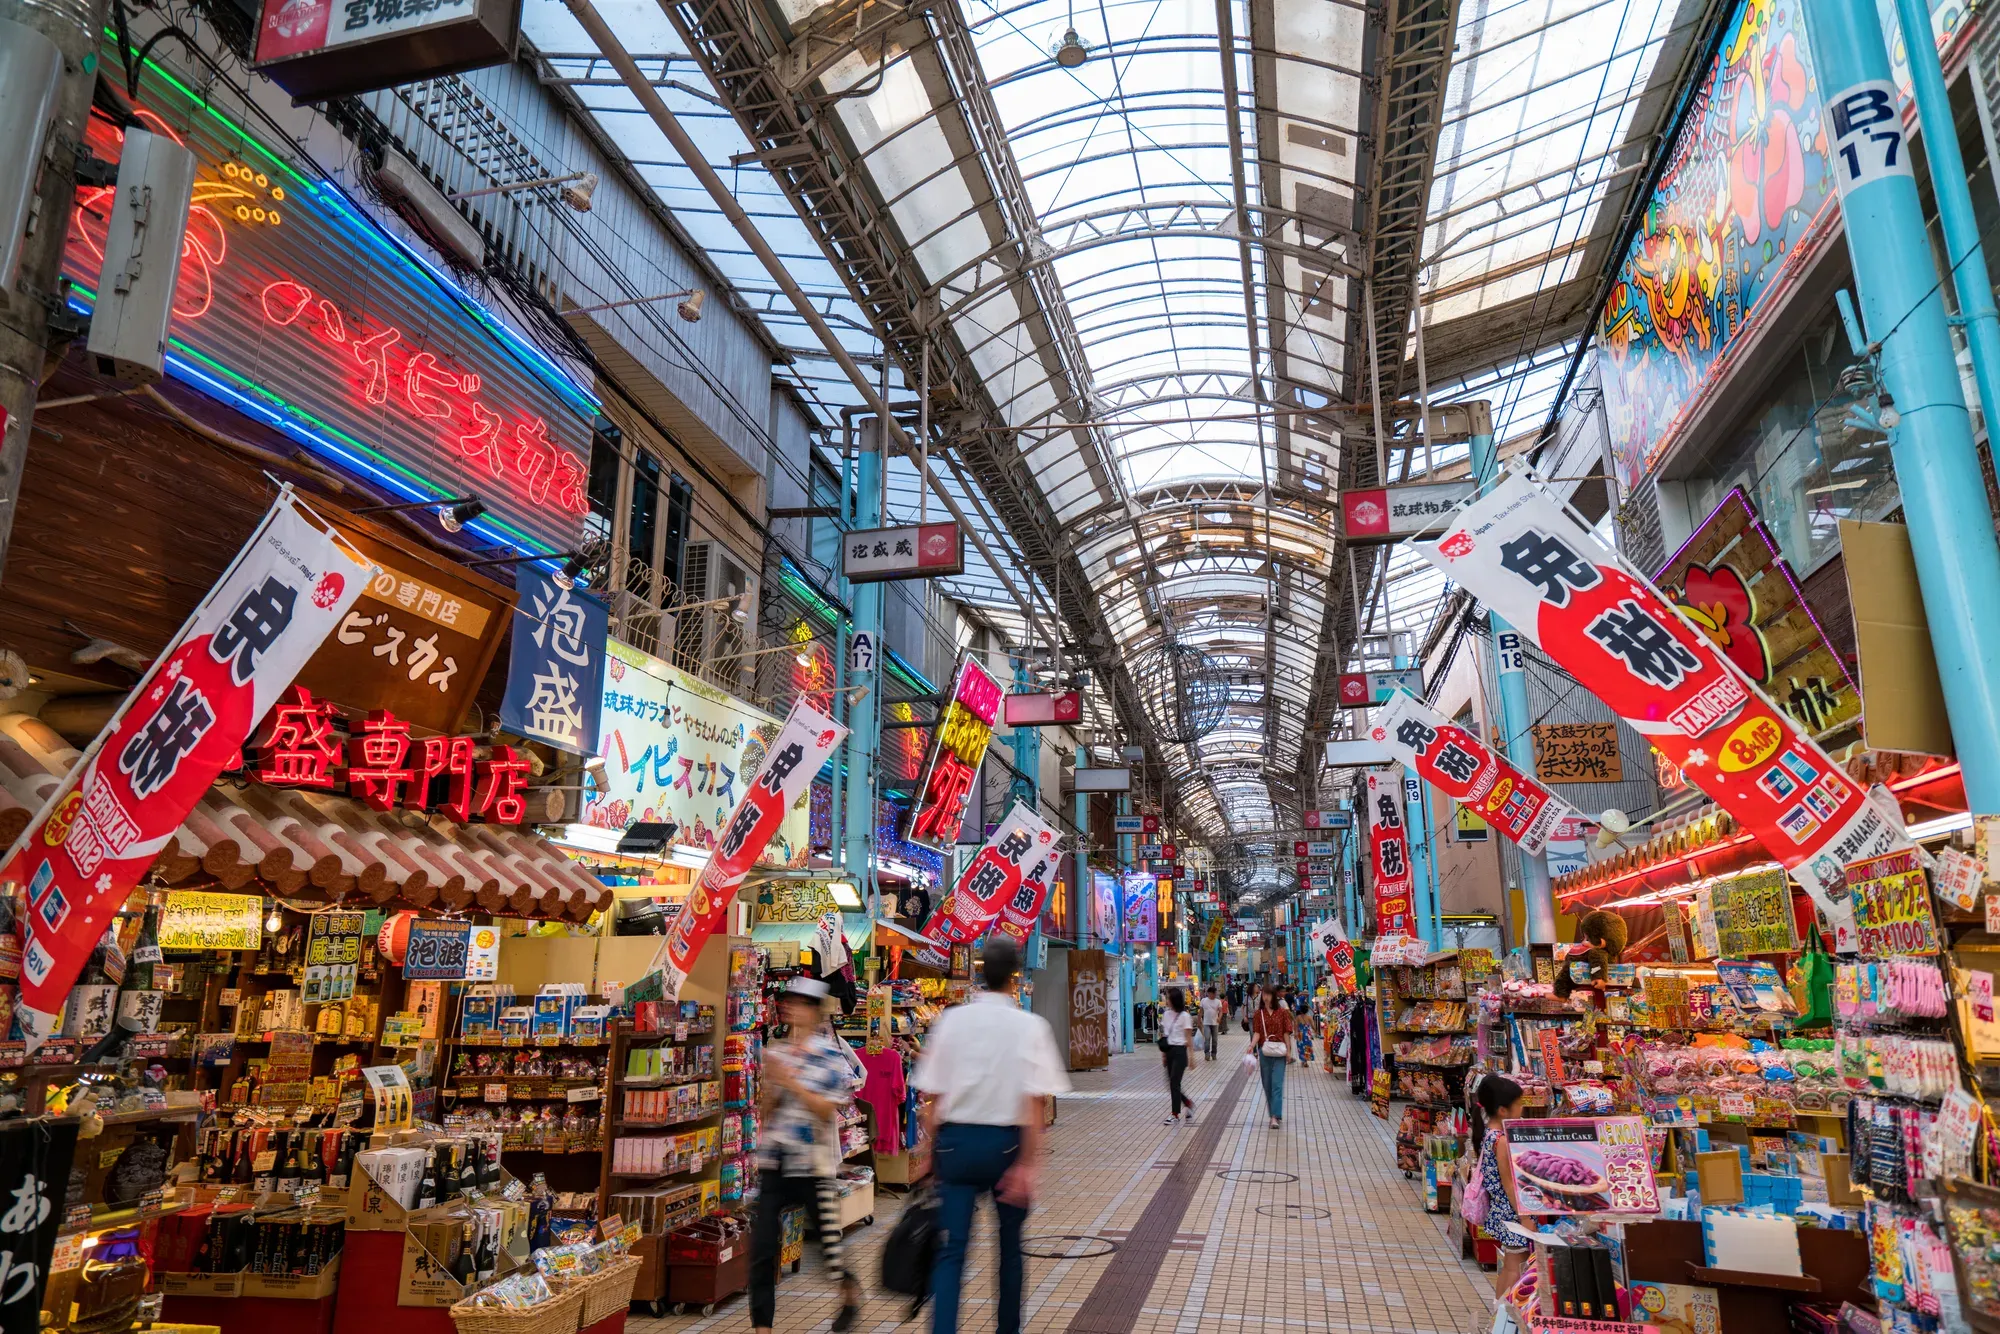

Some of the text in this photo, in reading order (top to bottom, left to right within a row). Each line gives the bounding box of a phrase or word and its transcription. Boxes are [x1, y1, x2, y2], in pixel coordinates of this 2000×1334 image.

[1840, 131, 1901, 181] 17
[262, 280, 590, 516] ハイビスカス
[1473, 490, 1538, 537] Japan. Tax-free Shop
[851, 539, 914, 559] 泡盛蔵
[354, 560, 462, 626] の専門店
[1499, 529, 1700, 686] 免税
[524, 579, 590, 745] 泡盛
[852, 652, 873, 669] 17
[1501, 653, 1523, 670] 18
[1673, 680, 1743, 736] TAX FREE
[1781, 676, 1842, 732] カス
[1545, 724, 1615, 740] 太鼓ライブ
[1545, 740, 1617, 758] ケン坊の店
[1728, 720, 1780, 765] 8%OFF
[222, 687, 531, 826] 盛専門店
[600, 728, 736, 809] ハイビスカス
[1396, 718, 1480, 784] 免税
[1406, 791, 1419, 801] 19
[1469, 784, 1486, 802] TAX
[1481, 766, 1498, 792] FREE
[1377, 792, 1404, 877] 免税
[1790, 816, 1811, 833] VISA
[1556, 864, 1578, 874] VAN
[776, 880, 834, 902] T-Shirt
[309, 936, 360, 966] 威士忌
[379, 921, 392, 954] Orion
[408, 938, 467, 968] 泡波
[1323, 933, 1352, 969] 免税
[1513, 1132, 1594, 1142] BENIIMO TARTE CAKE
[1610, 1184, 1656, 1208] たると
